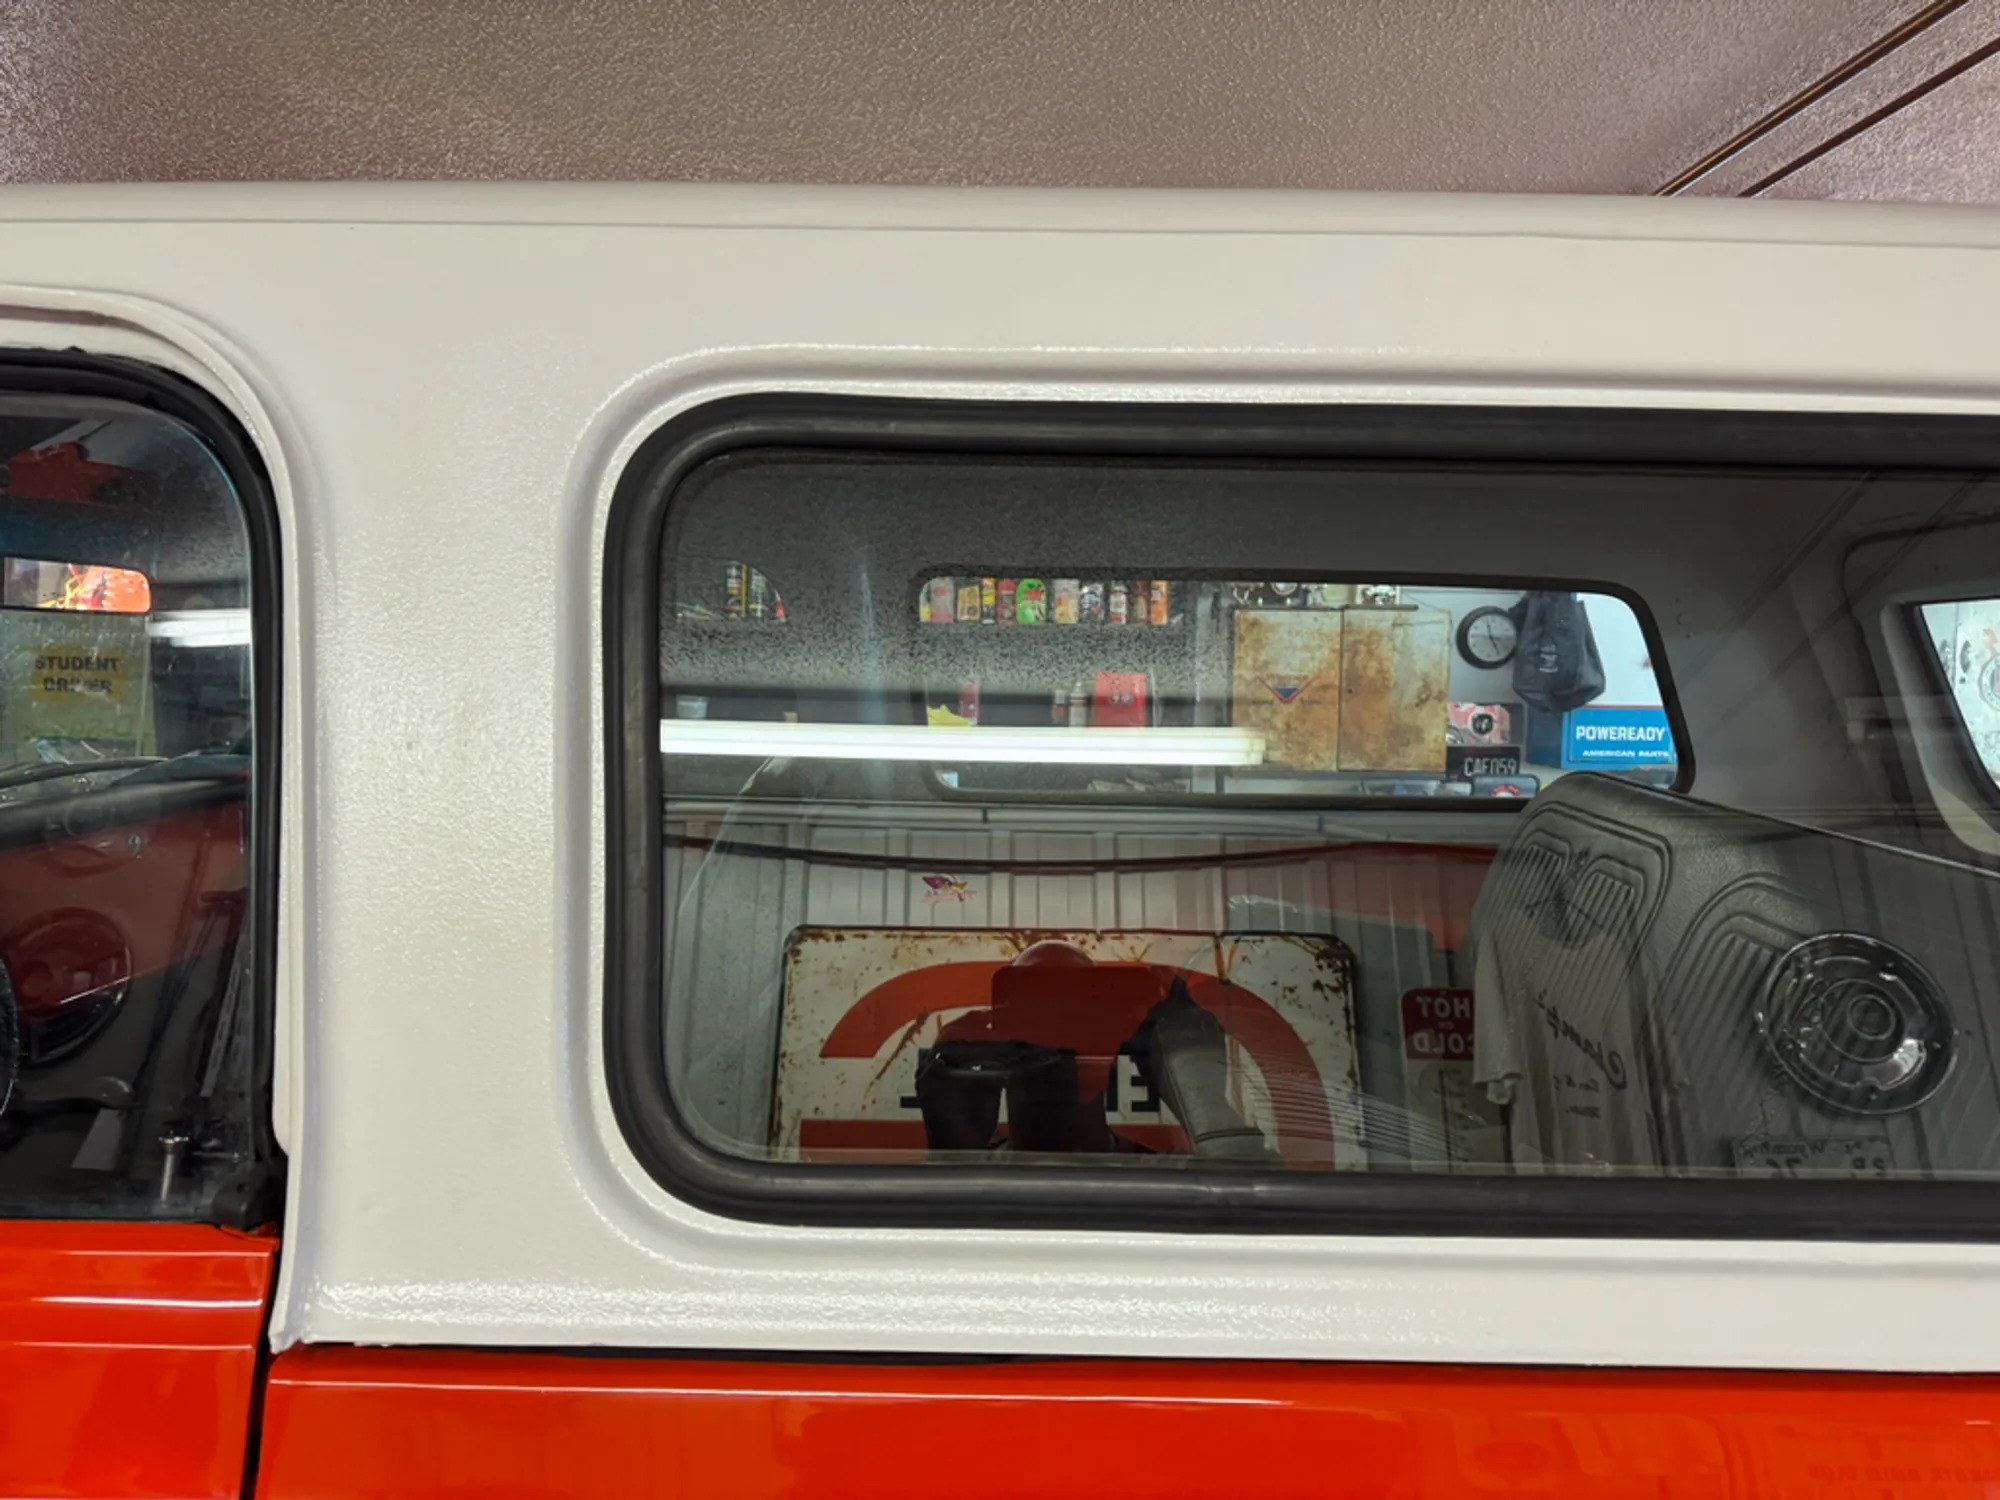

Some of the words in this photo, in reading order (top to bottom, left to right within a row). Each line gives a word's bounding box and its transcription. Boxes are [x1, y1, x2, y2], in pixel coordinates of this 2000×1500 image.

[34, 655, 121, 671] STUDENT
[1575, 725, 1665, 741] POWEREADY
[1582, 750, 1636, 758] AMERICAN
